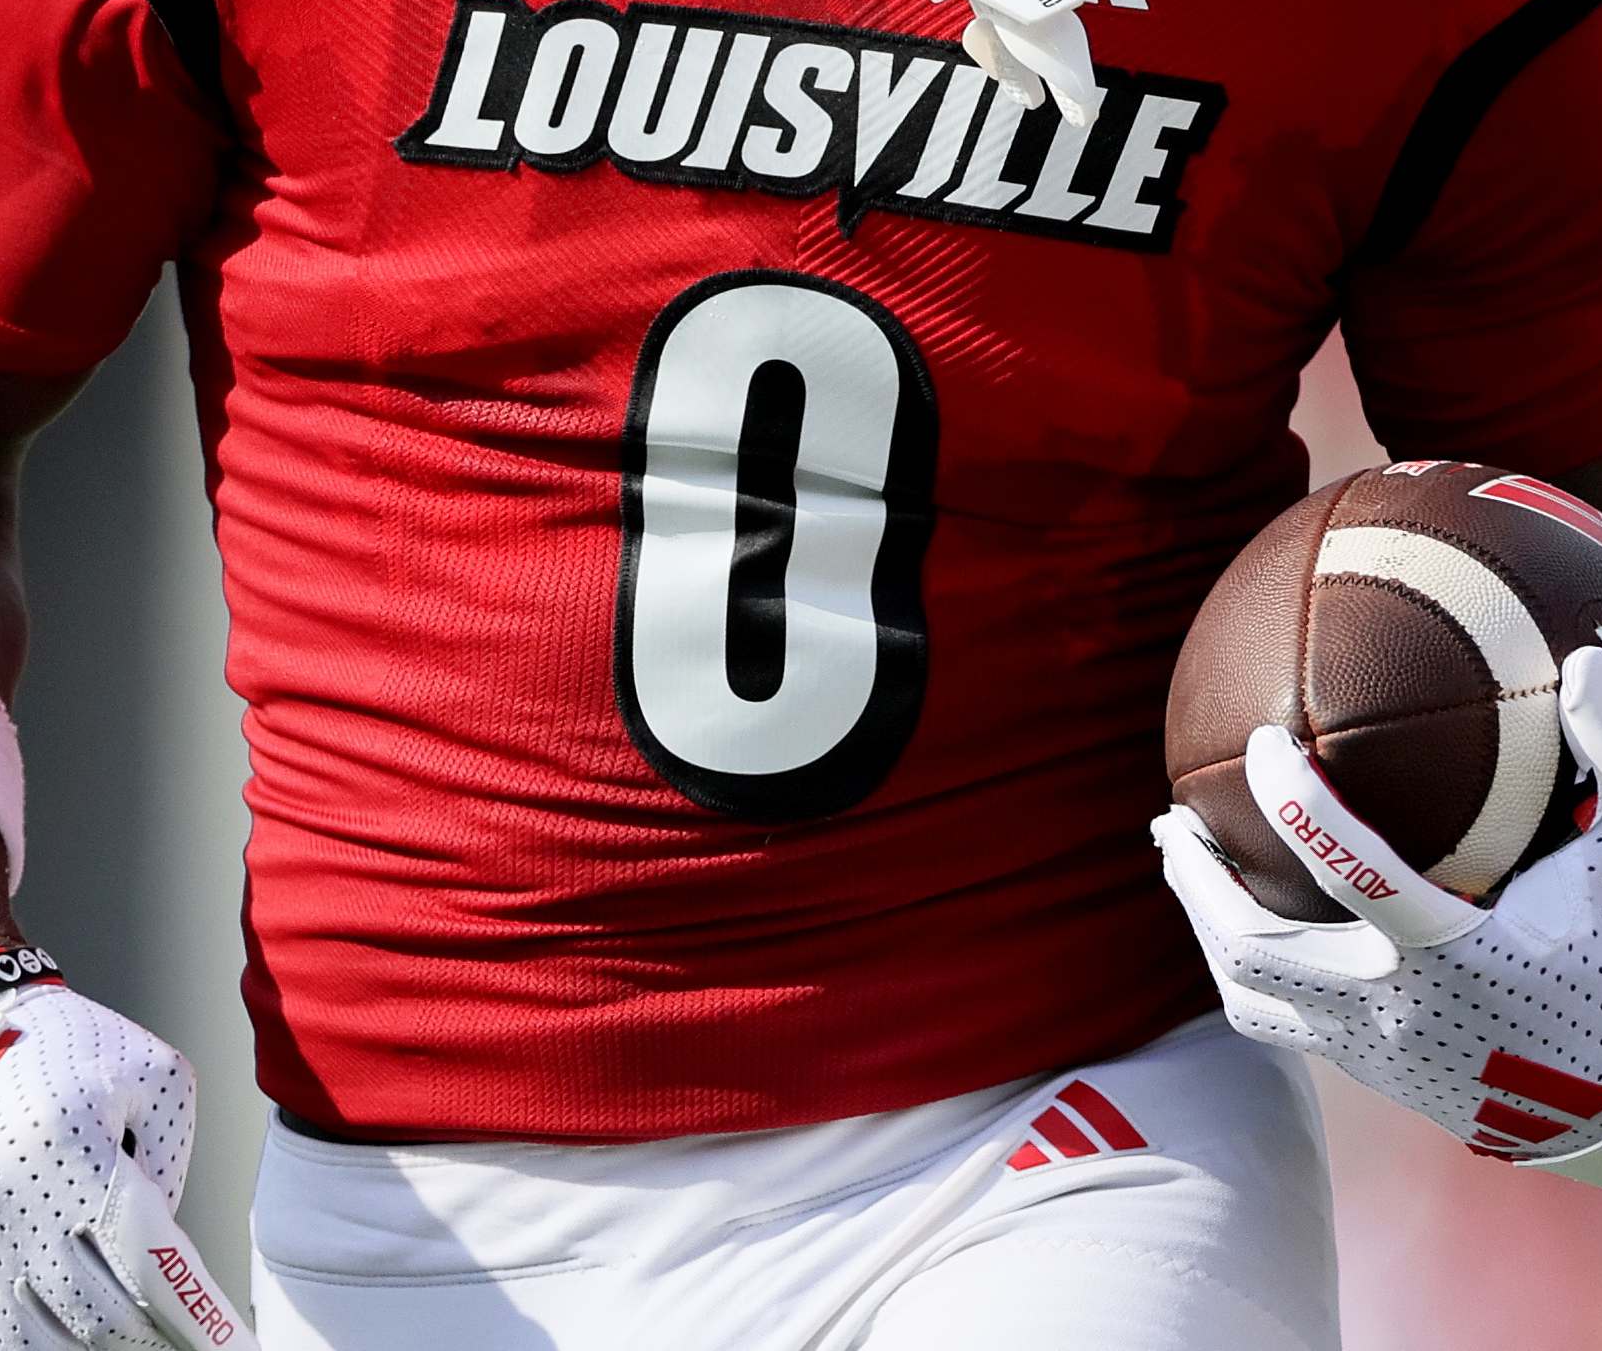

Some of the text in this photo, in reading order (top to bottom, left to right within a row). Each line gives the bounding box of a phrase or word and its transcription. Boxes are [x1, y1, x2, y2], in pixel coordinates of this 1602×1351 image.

[424, 9, 1201, 234] LOUISVILLE
[632, 284, 899, 775] 0
[1278, 800, 1400, 901] ADIZERO
[147, 1246, 235, 1346] ADIZERO
